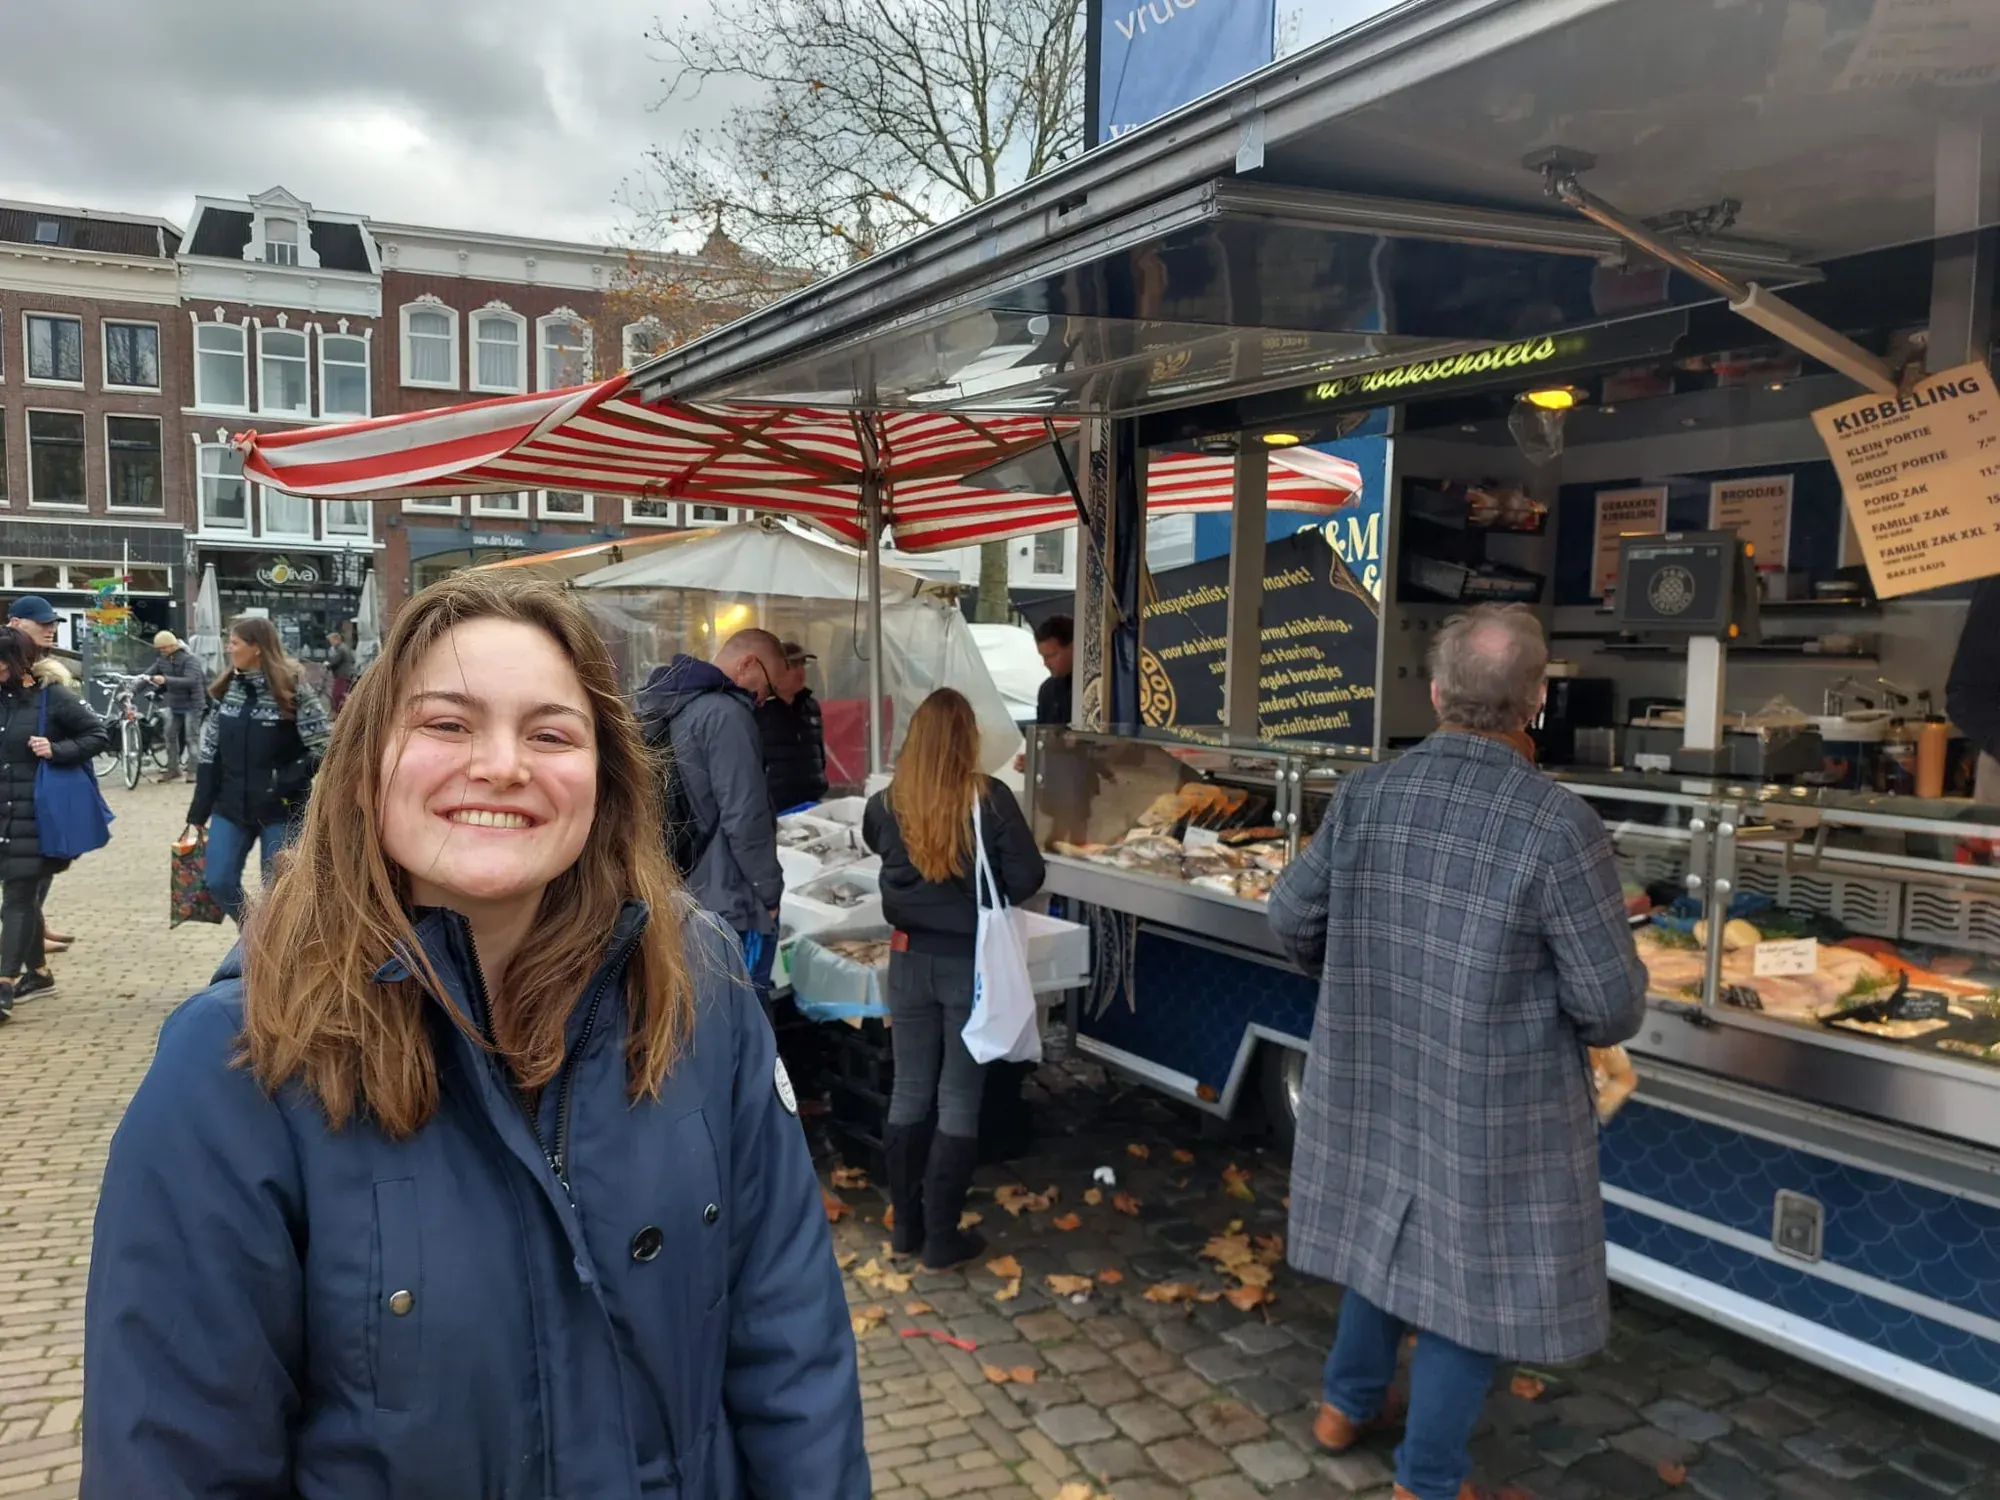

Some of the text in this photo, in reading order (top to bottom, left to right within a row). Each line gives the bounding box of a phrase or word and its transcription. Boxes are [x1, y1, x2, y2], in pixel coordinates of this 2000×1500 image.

[1833, 376, 1980, 433] KIBBELING
[1846, 440, 1883, 458] KLEIN
[1885, 426, 1932, 449] PORTIE
[1856, 463, 1898, 483] GROOT
[1901, 450, 1948, 471] PORTIE
[1721, 485, 1784, 501] BROODJES
[1863, 491, 1899, 508] POND
[1902, 483, 1929, 498] ZAK
[1871, 514, 1922, 533] FAMILIE
[1923, 506, 1950, 521] ZAK
[1880, 540, 1929, 559] FAMILIE
[1931, 532, 1958, 547] ZAK
[1960, 527, 1986, 539] XXL
[1150, 585, 1226, 616] visspecialist
[1263, 566, 1315, 592] markt!
[1158, 645, 1183, 661] voor
[1183, 640, 1197, 656] de
[1287, 663, 1343, 683] broodjes
[1296, 685, 1351, 708] Vitamin
[1349, 683, 1376, 700] Sea
